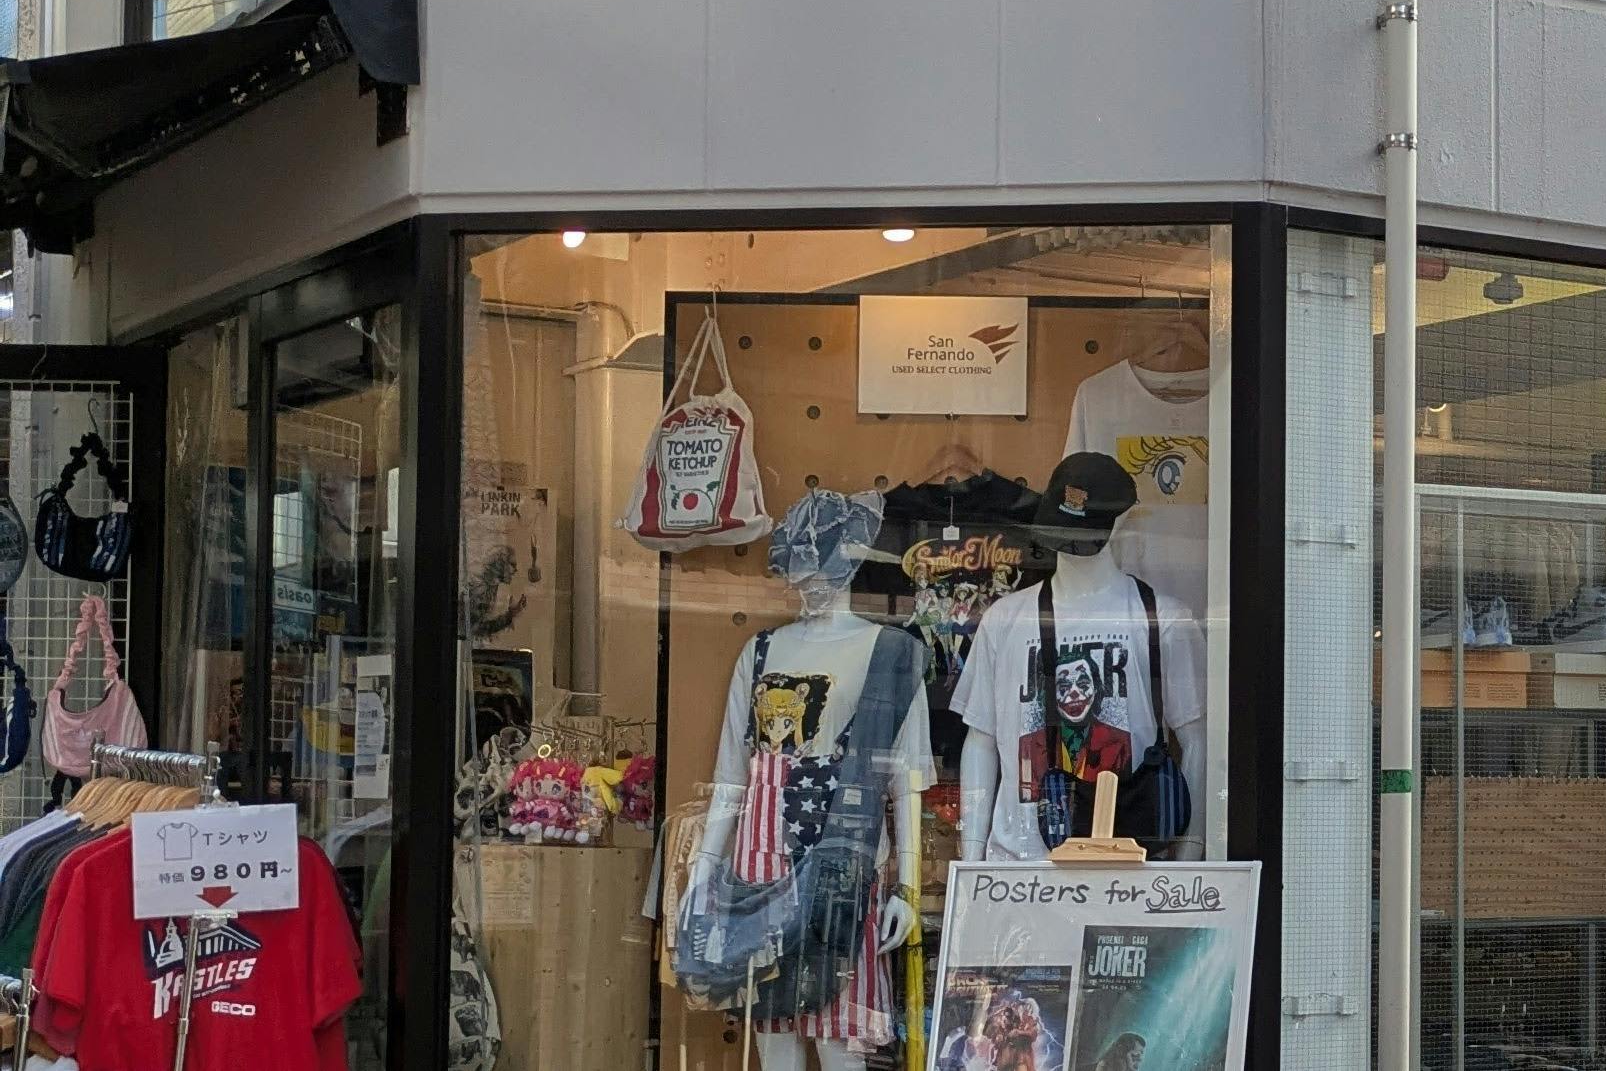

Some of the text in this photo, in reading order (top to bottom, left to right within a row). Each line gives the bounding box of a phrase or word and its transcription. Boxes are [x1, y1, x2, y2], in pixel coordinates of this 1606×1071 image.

[928, 335, 954, 348] San
[907, 348, 975, 361] Fernando
[892, 365, 992, 375] USED SELECT CLOTHING
[667, 438, 722, 456] TOMATO
[668, 455, 717, 470] KETCHUP
[481, 502, 521, 519] PARK
[963, 533, 1023, 571] Moon
[202, 830, 268, 846] Tシャツ
[973, 874, 1220, 911] Posters for Sale
[1088, 945, 1147, 977] JOKER
